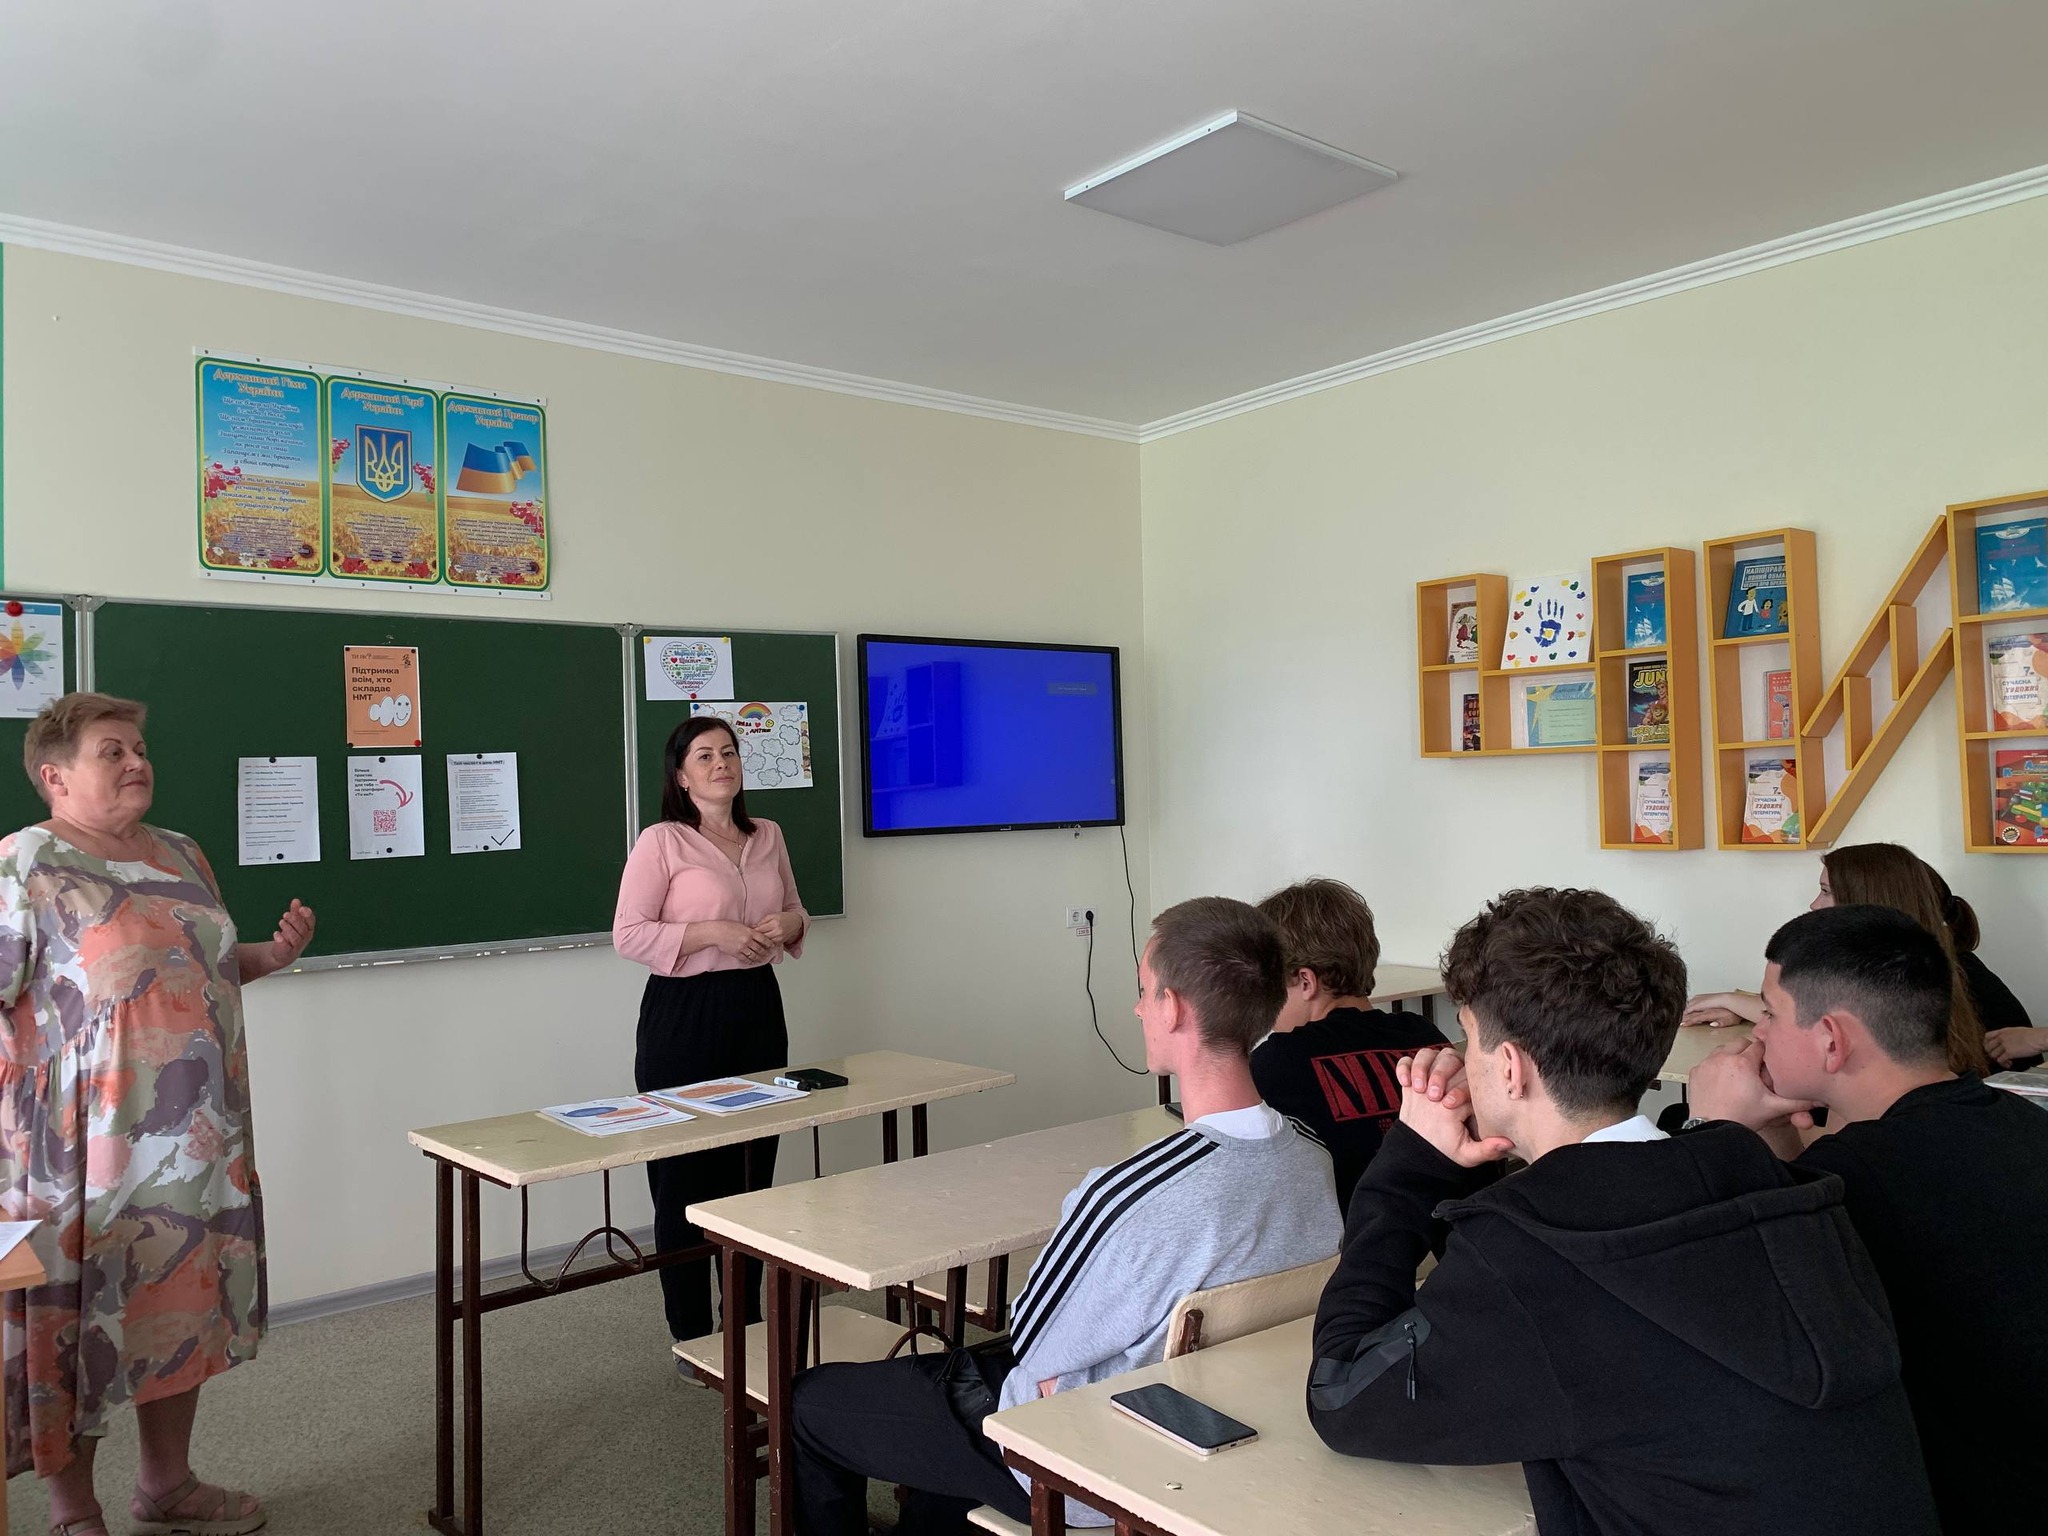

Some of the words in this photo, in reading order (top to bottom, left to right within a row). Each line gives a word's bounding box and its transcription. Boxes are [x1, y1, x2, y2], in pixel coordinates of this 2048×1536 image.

[237, 382, 284, 398] України
[362, 400, 404, 416] України
[475, 414, 514, 429] України
[351, 666, 400, 675] Підтримка
[1633, 668, 1668, 688] JUN
[352, 676, 375, 684] всім,
[352, 693, 373, 701] НМТ
